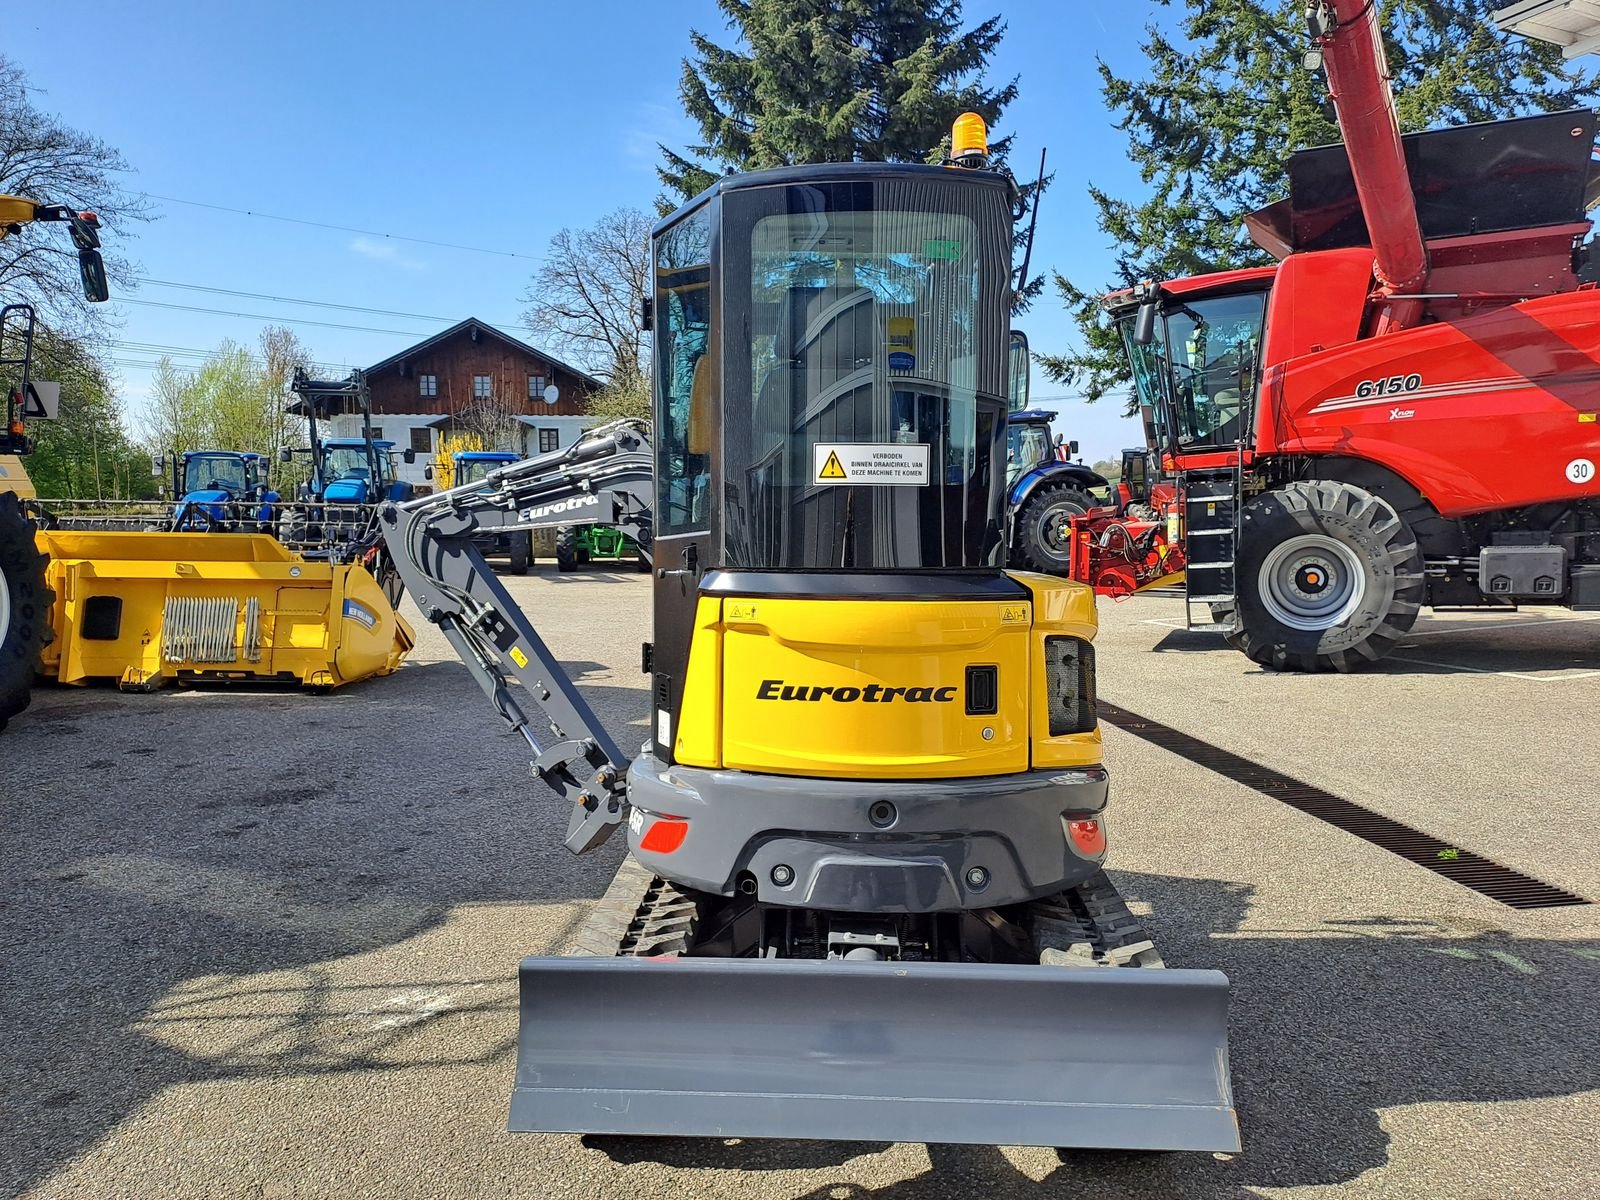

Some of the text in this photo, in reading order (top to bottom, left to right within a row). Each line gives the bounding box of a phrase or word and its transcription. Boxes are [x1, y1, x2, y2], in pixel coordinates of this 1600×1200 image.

[1355, 373, 1422, 398] 6150
[1573, 464, 1588, 479] 30
[756, 680, 958, 703] Eurotrac
